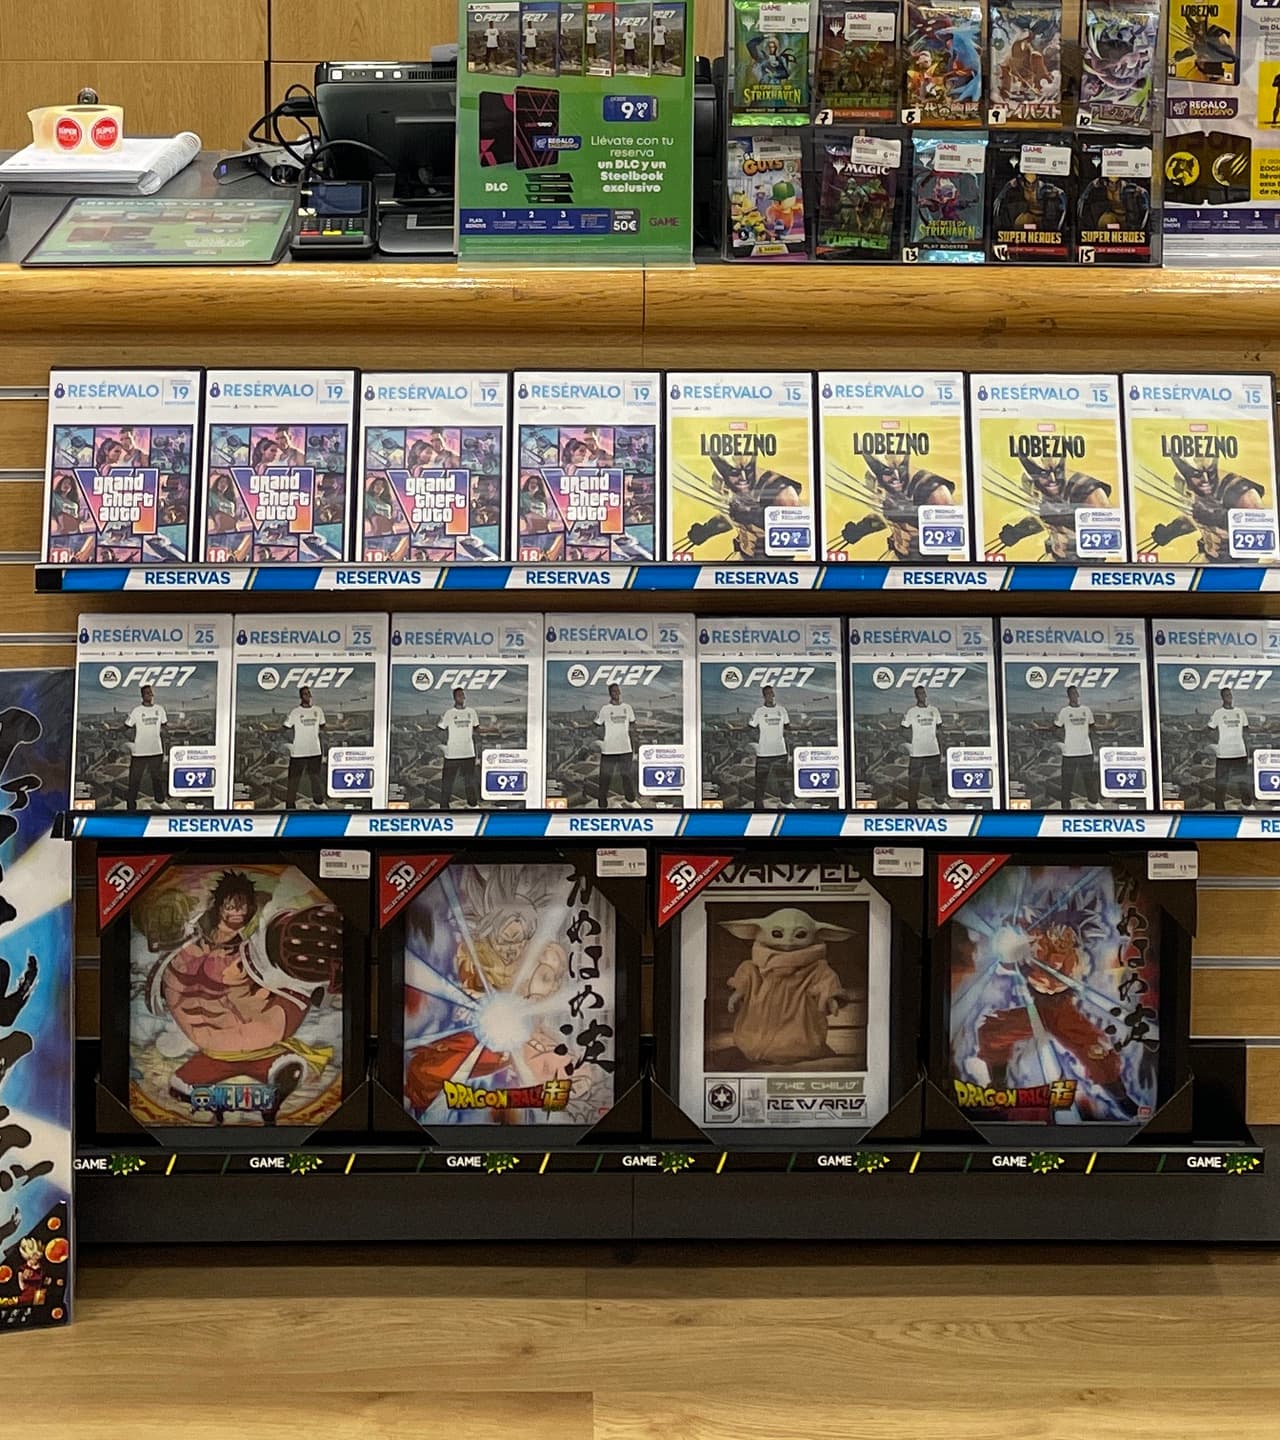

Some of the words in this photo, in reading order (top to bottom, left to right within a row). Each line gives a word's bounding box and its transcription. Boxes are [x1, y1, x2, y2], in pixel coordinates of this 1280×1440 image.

[743, 87, 802, 104] STRIXHAVEN
[592, 135, 633, 147] Llévate
[661, 136, 675, 146] tu
[610, 149, 654, 158] reserva
[615, 161, 637, 169] DLC
[843, 163, 890, 176] MAGIC
[600, 171, 663, 181] Steelbook
[602, 183, 661, 193] exclusivo
[613, 220, 637, 232] 50€
[649, 216, 679, 227] GAME
[997, 232, 1028, 243] SUPER
[1031, 232, 1062, 244] HEROES
[68, 381, 159, 398] RESÉRVALO
[172, 385, 189, 400] 19
[991, 383, 1079, 402] RESÉRVALO
[1091, 390, 1109, 402] 15
[1008, 435, 1086, 459] LOBEZNO
[94, 475, 145, 495] grand
[103, 492, 154, 507] theft
[99, 506, 141, 522] auto
[144, 570, 231, 585] RESERVAS
[902, 570, 987, 586] RESERVAS
[91, 625, 184, 643] RESÉRVALO
[194, 629, 214, 644] 25
[121, 665, 197, 688] FC27
[168, 817, 254, 833] RESERVAS
[766, 1097, 866, 1112] REWARD
